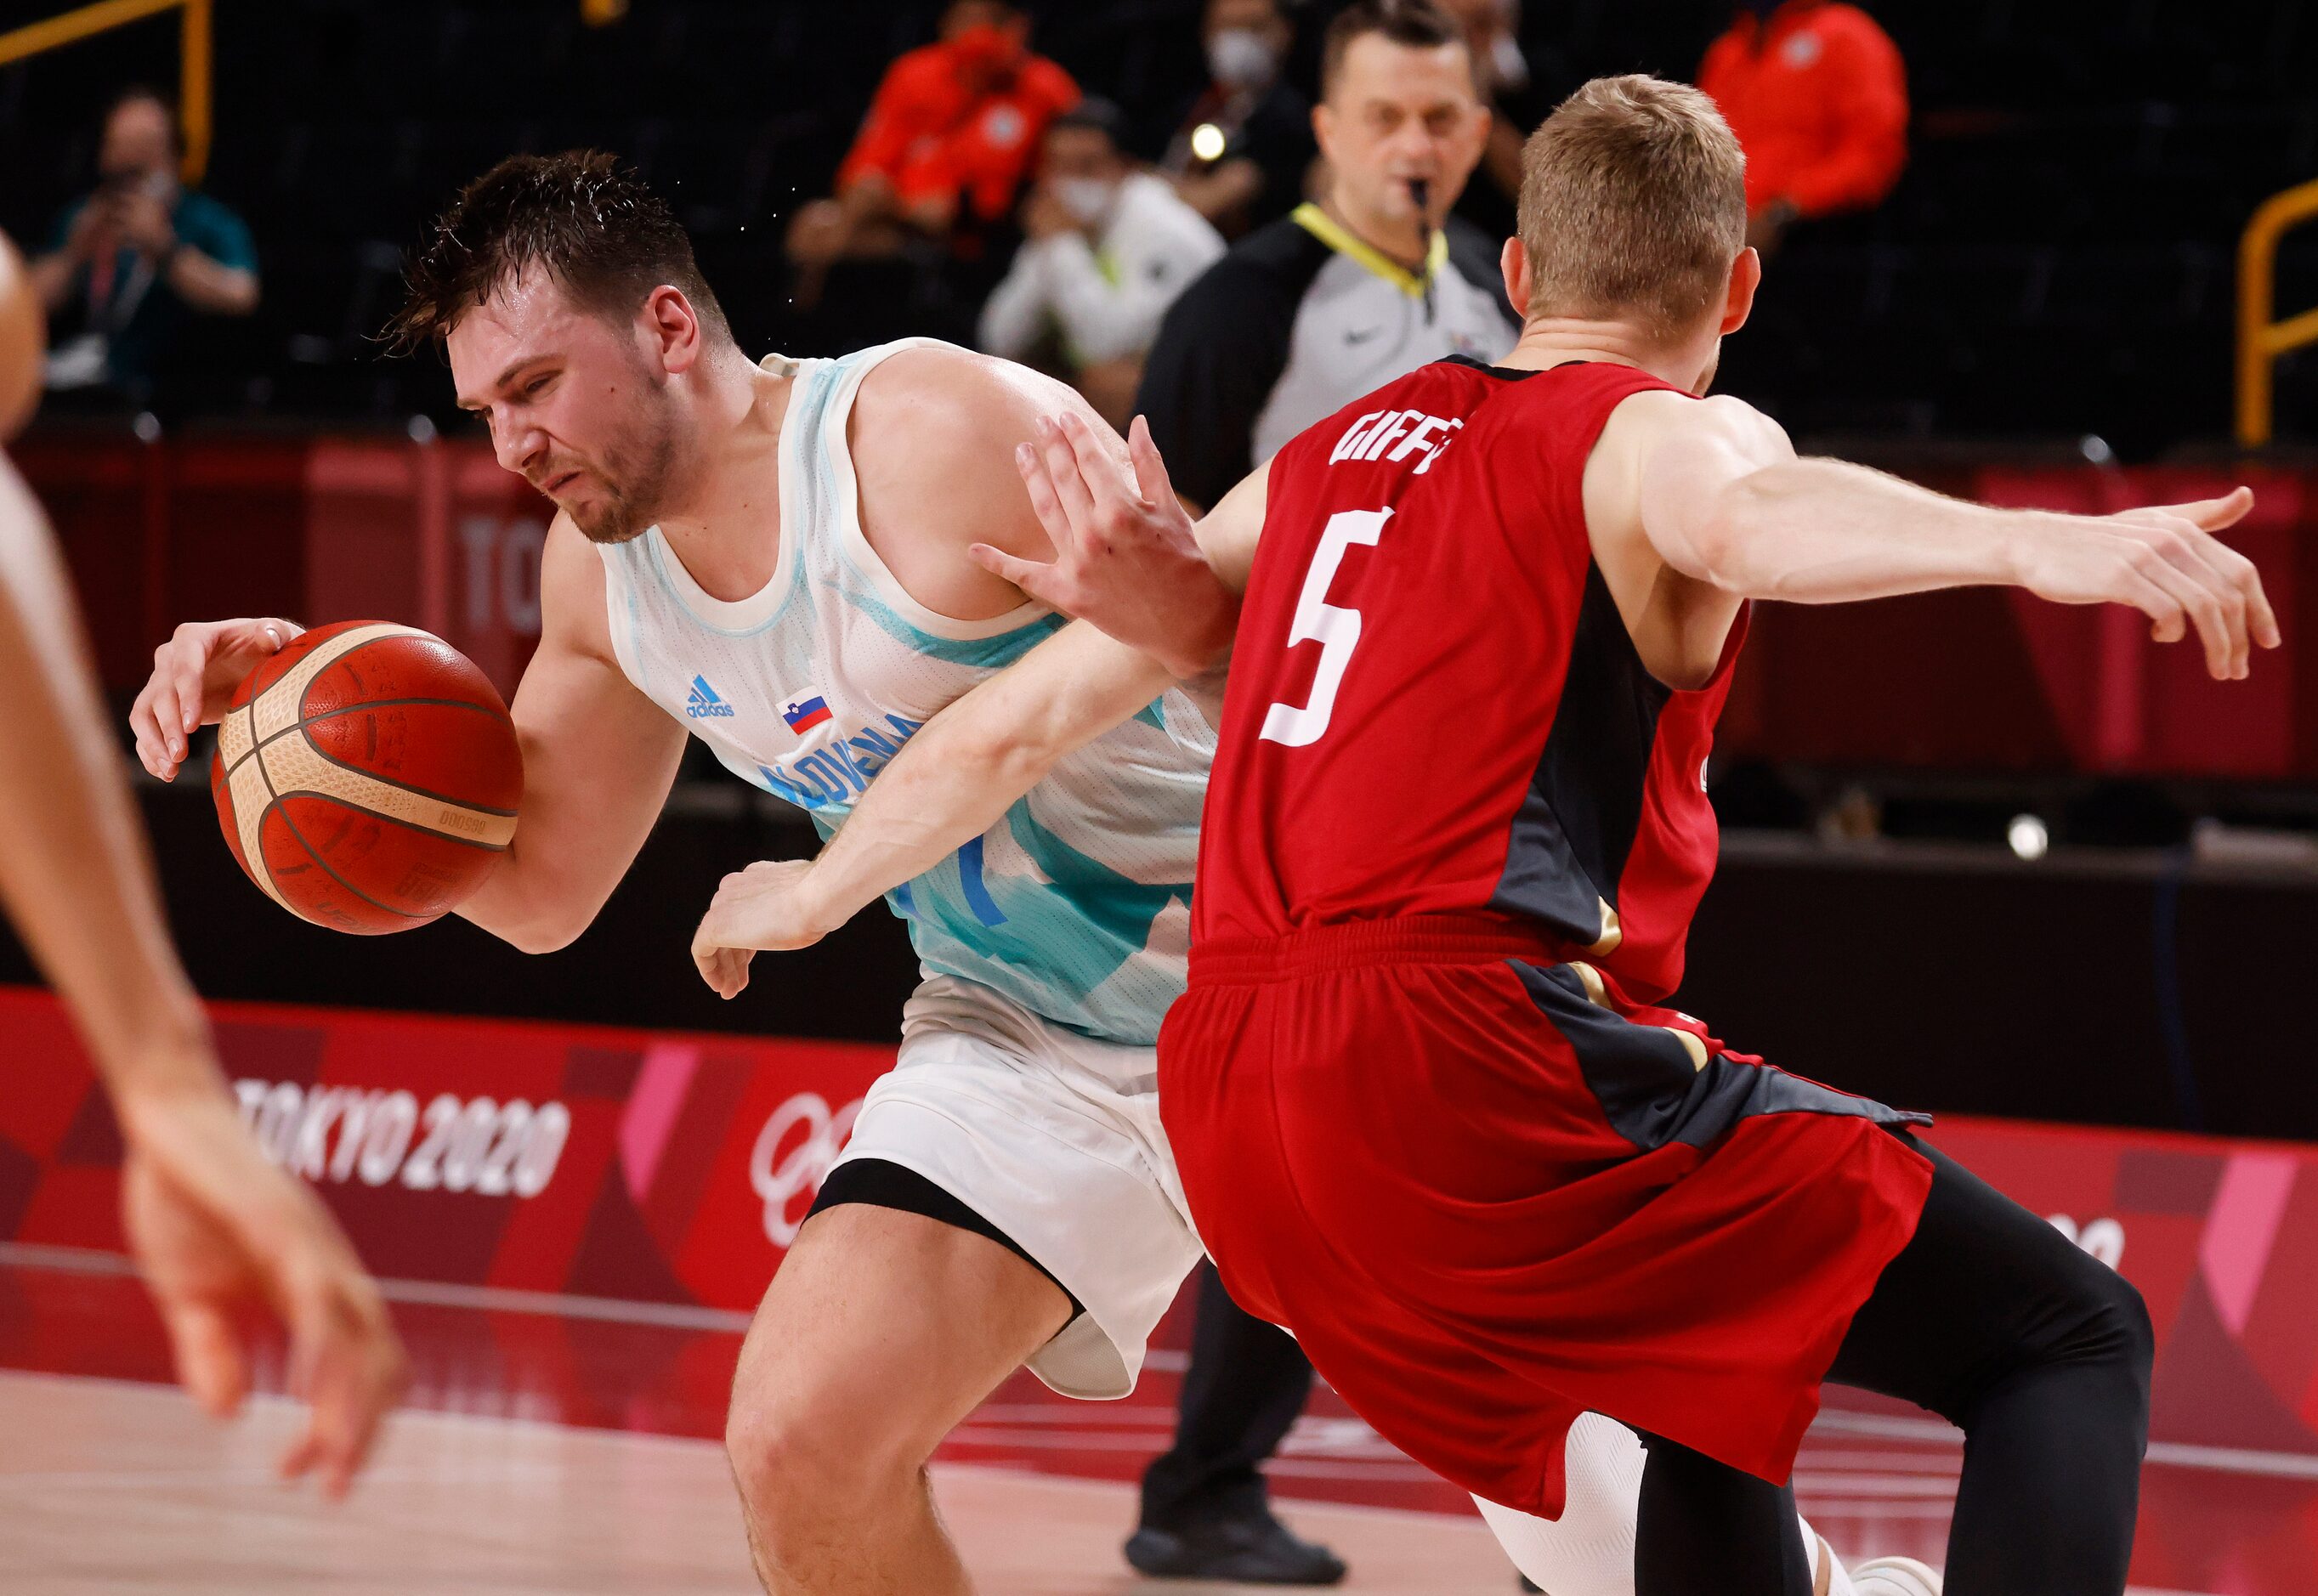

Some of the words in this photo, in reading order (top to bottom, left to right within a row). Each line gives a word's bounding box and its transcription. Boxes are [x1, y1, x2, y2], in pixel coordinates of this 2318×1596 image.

[1259, 506, 1396, 747] 5
[686, 700, 735, 718] adidas
[235, 1079, 418, 1185] TOKYO
[402, 1093, 570, 1198] 2020
